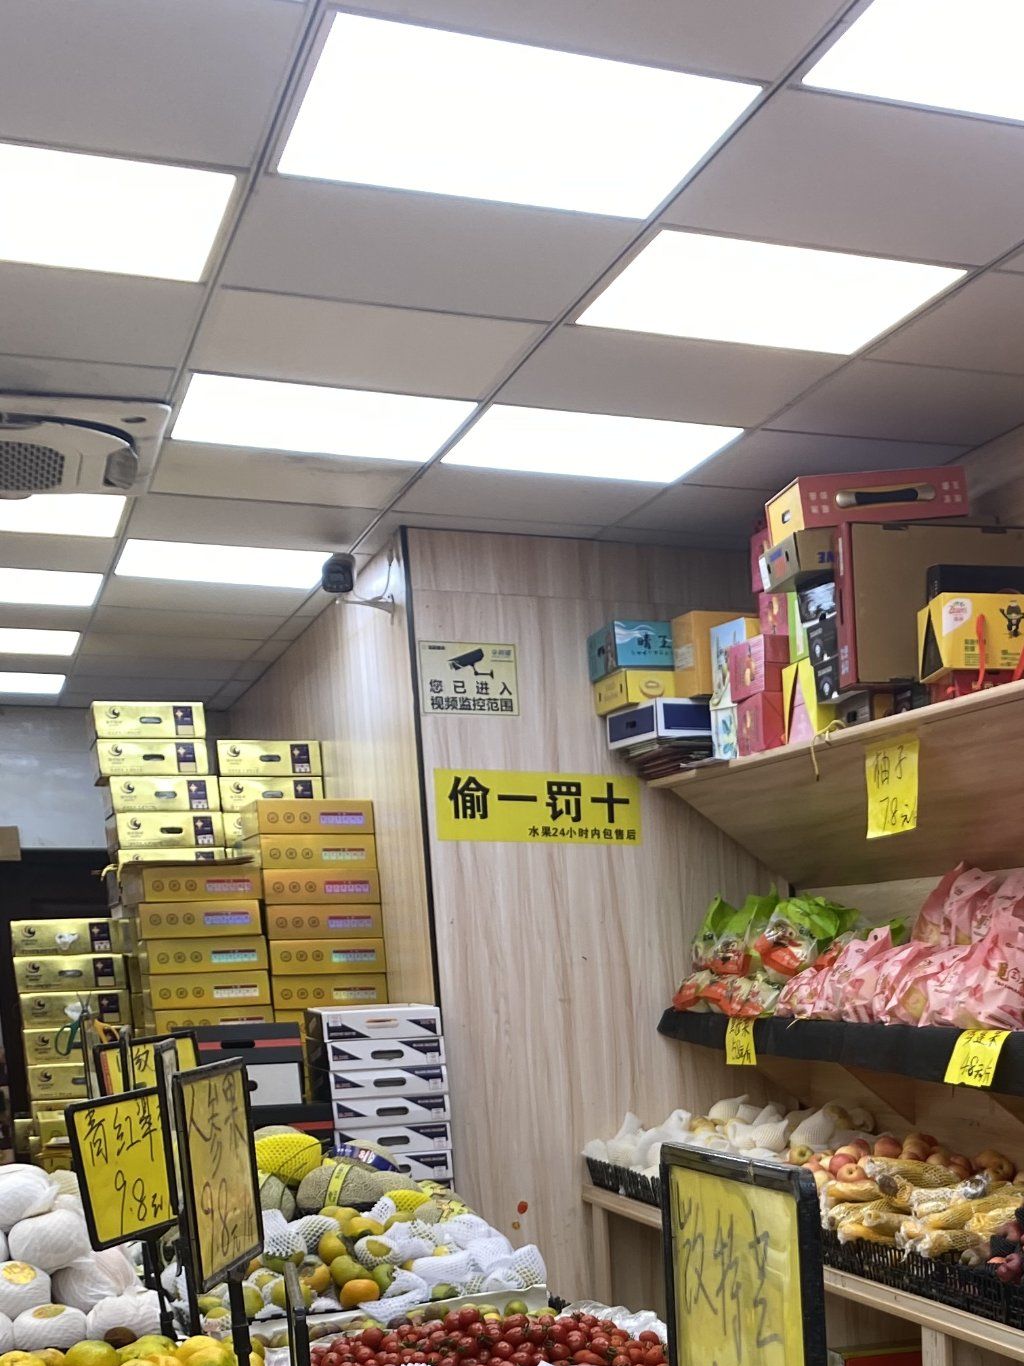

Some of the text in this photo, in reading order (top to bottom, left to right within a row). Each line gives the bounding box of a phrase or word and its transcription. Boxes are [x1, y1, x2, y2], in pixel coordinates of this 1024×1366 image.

[429, 679, 512, 695] 您已进入
[430, 696, 514, 712] 视频监控范围
[448, 776, 630, 823] 偷一罚十
[528, 826, 636, 841] 水果24小时内包售后
[83, 1096, 163, 1168] 青红苹
